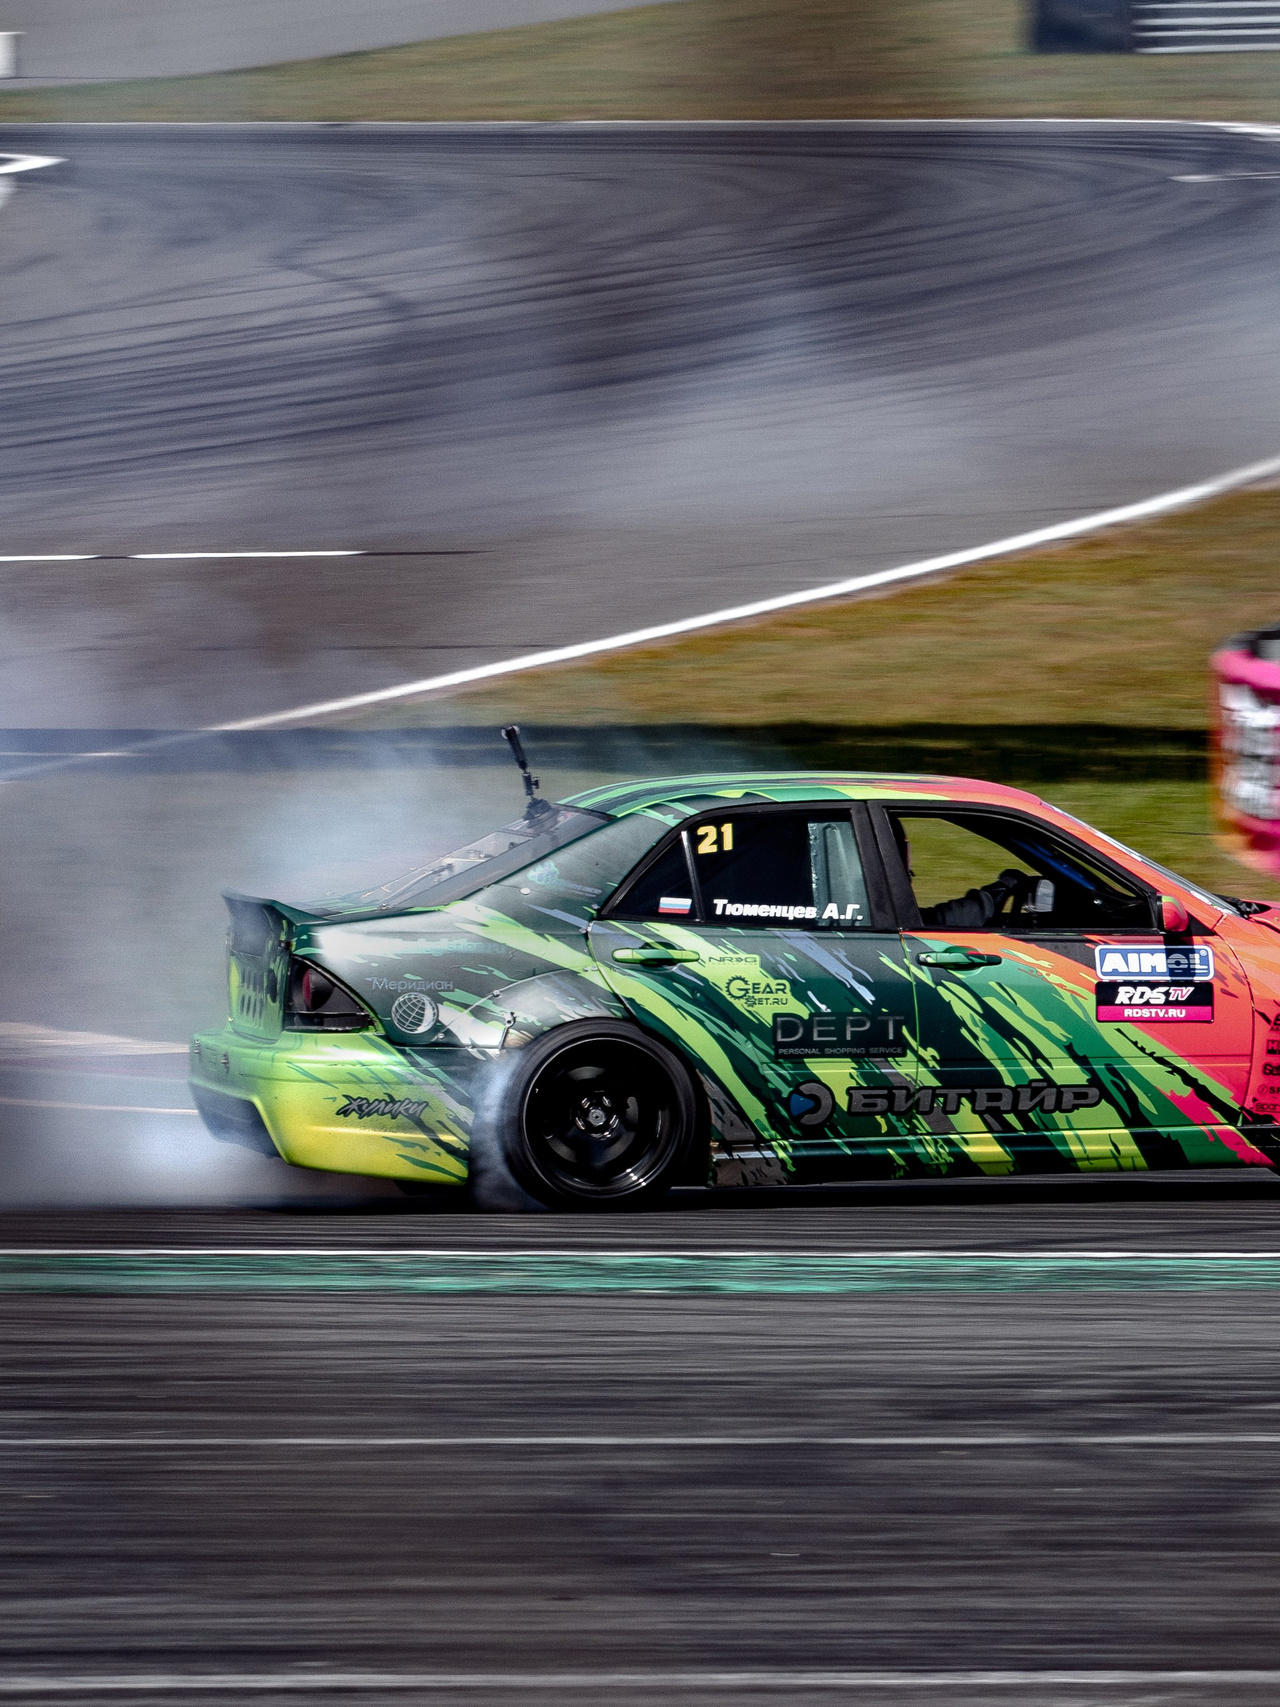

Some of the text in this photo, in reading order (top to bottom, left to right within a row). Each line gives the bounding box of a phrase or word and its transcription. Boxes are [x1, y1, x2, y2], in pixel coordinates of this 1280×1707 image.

[698, 823, 733, 854] 21
[713, 898, 864, 920] Тюменцев А.Г.
[1101, 952, 1209, 973] AIMOL
[371, 977, 454, 992] Меридиан
[725, 975, 788, 1000] GEAR
[1124, 1008, 1186, 1018] RDSTV.RU
[776, 1016, 904, 1042] DEPT
